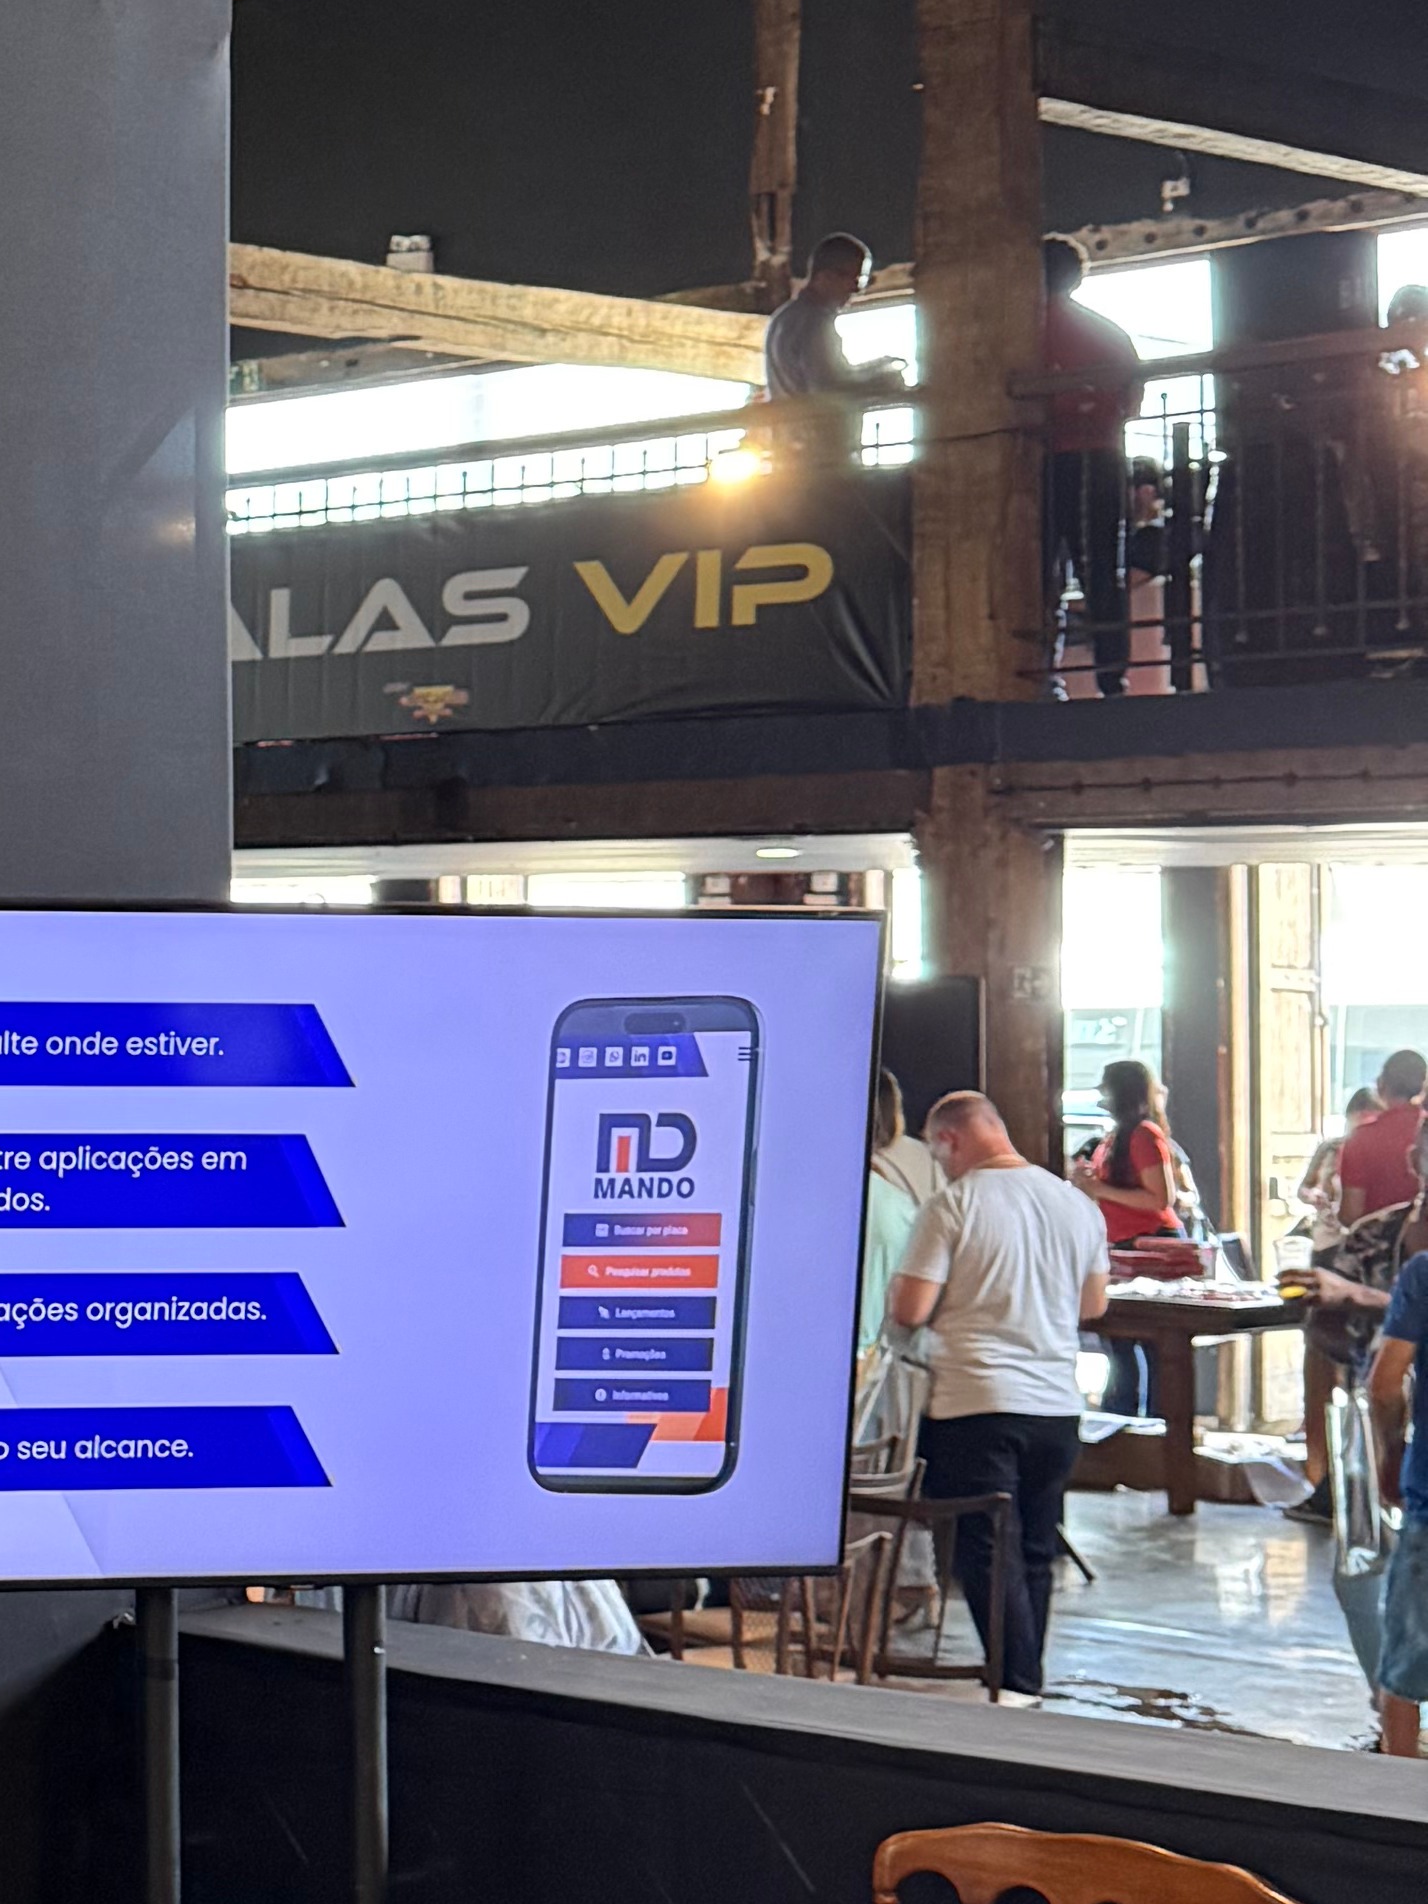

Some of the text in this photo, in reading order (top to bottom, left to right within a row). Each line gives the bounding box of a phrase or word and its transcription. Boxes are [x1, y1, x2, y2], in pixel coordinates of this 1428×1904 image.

[574, 543, 834, 635] VIP
[45, 1031, 119, 1056] onde
[125, 1031, 225, 1056] estiver.
[38, 1145, 194, 1178] aplicações
[201, 1149, 247, 1171] em
[593, 1177, 695, 1199] MANDO
[86, 1296, 267, 1329] organizadas.
[16, 1440, 67, 1460] seu
[74, 1435, 194, 1460] alcance.
